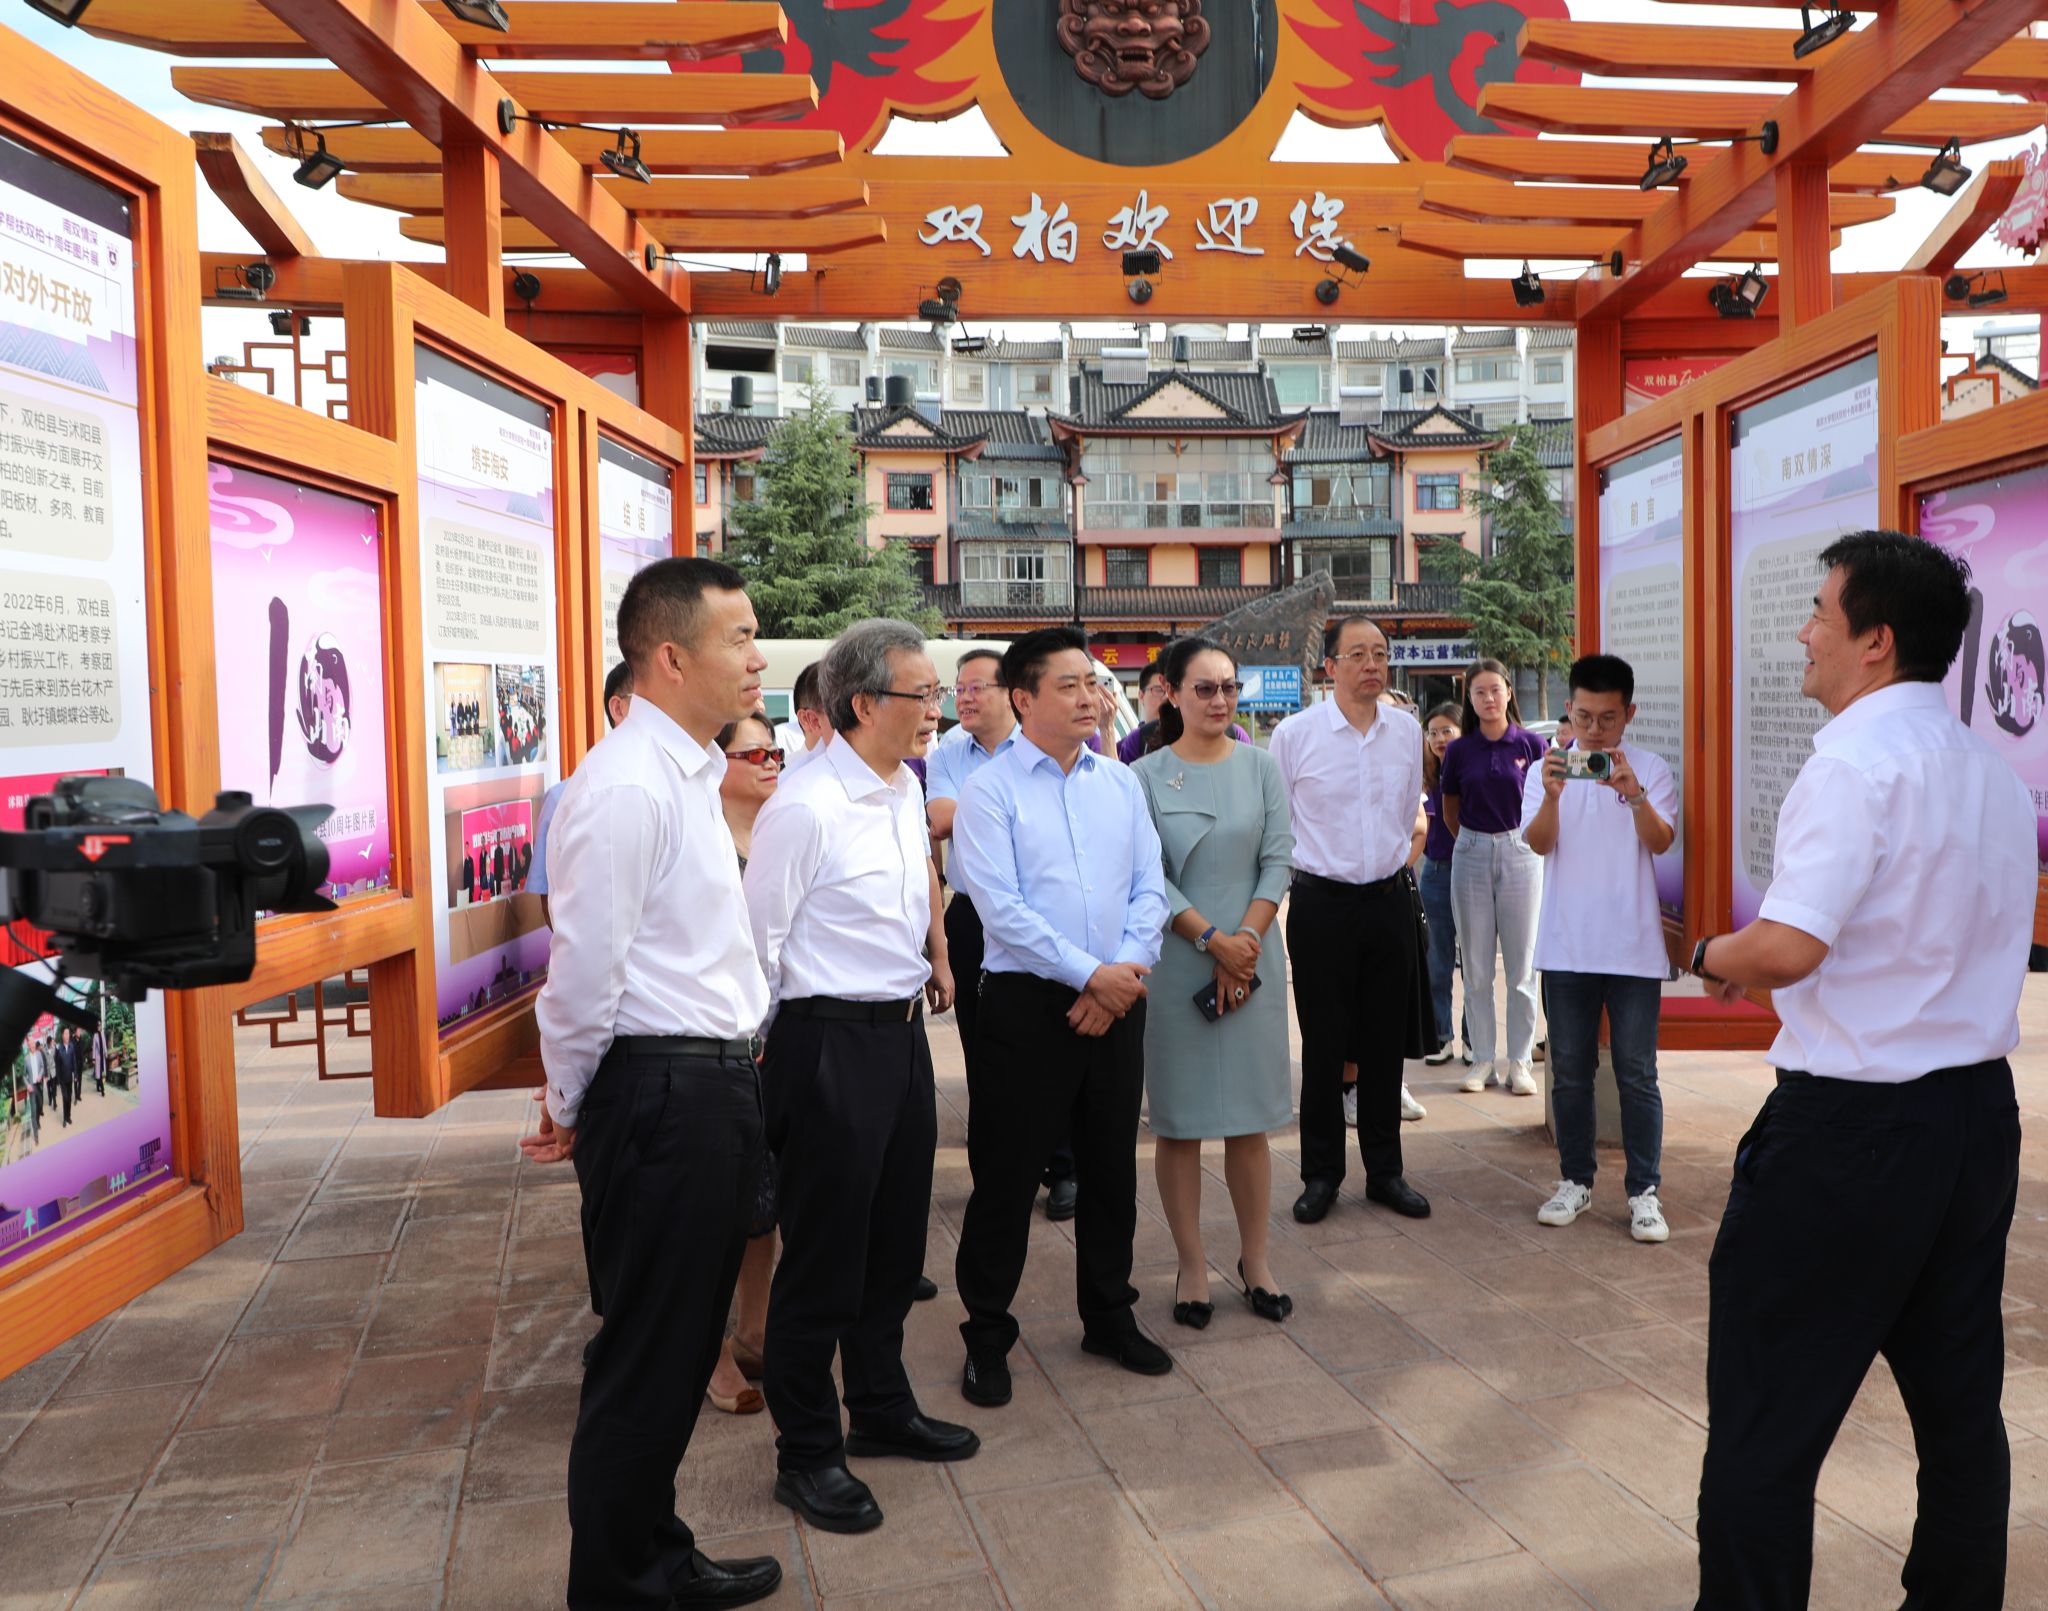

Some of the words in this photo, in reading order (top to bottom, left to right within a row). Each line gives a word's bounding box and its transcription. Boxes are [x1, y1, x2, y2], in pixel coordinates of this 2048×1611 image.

[63, 218, 98, 245] 南双情深
[918, 189, 1354, 263] 双柏欢迎您
[1782, 443, 1832, 481] 南双情深
[314, 809, 376, 838] 县10周年图片展
